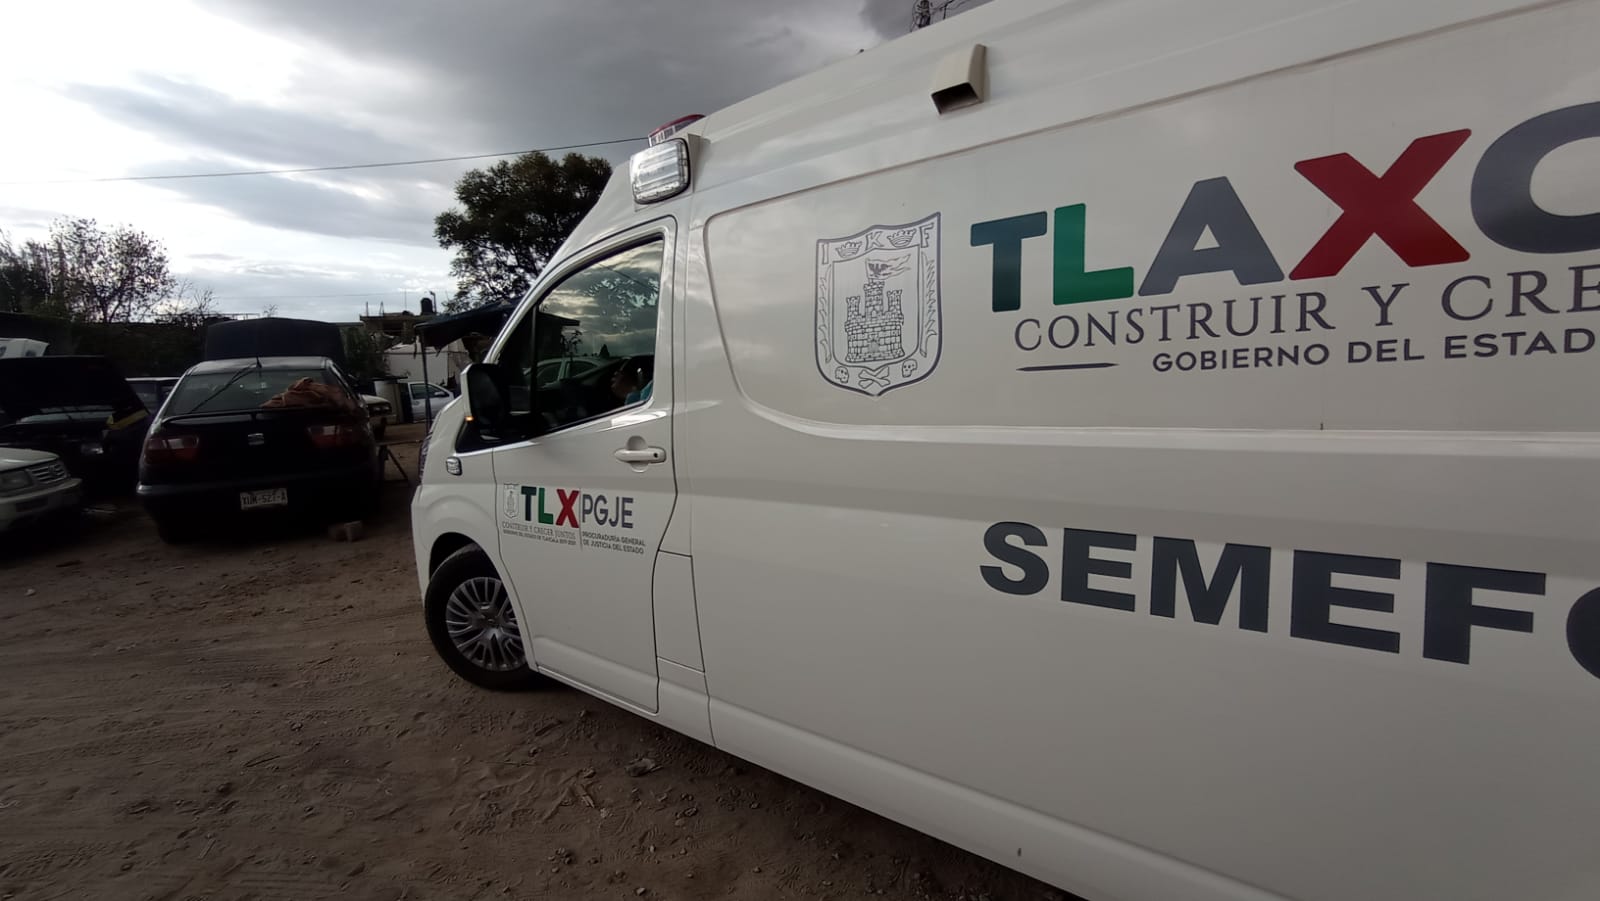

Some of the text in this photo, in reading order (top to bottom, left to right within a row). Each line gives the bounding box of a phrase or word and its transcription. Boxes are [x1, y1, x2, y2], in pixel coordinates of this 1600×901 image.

[1014, 264, 1600, 352] CONSTRUIR Y CRE
[1152, 328, 1596, 373] GOBIERNO DEL ESTAD
[521, 486, 580, 529] TLX
[582, 494, 634, 529] PGJE
